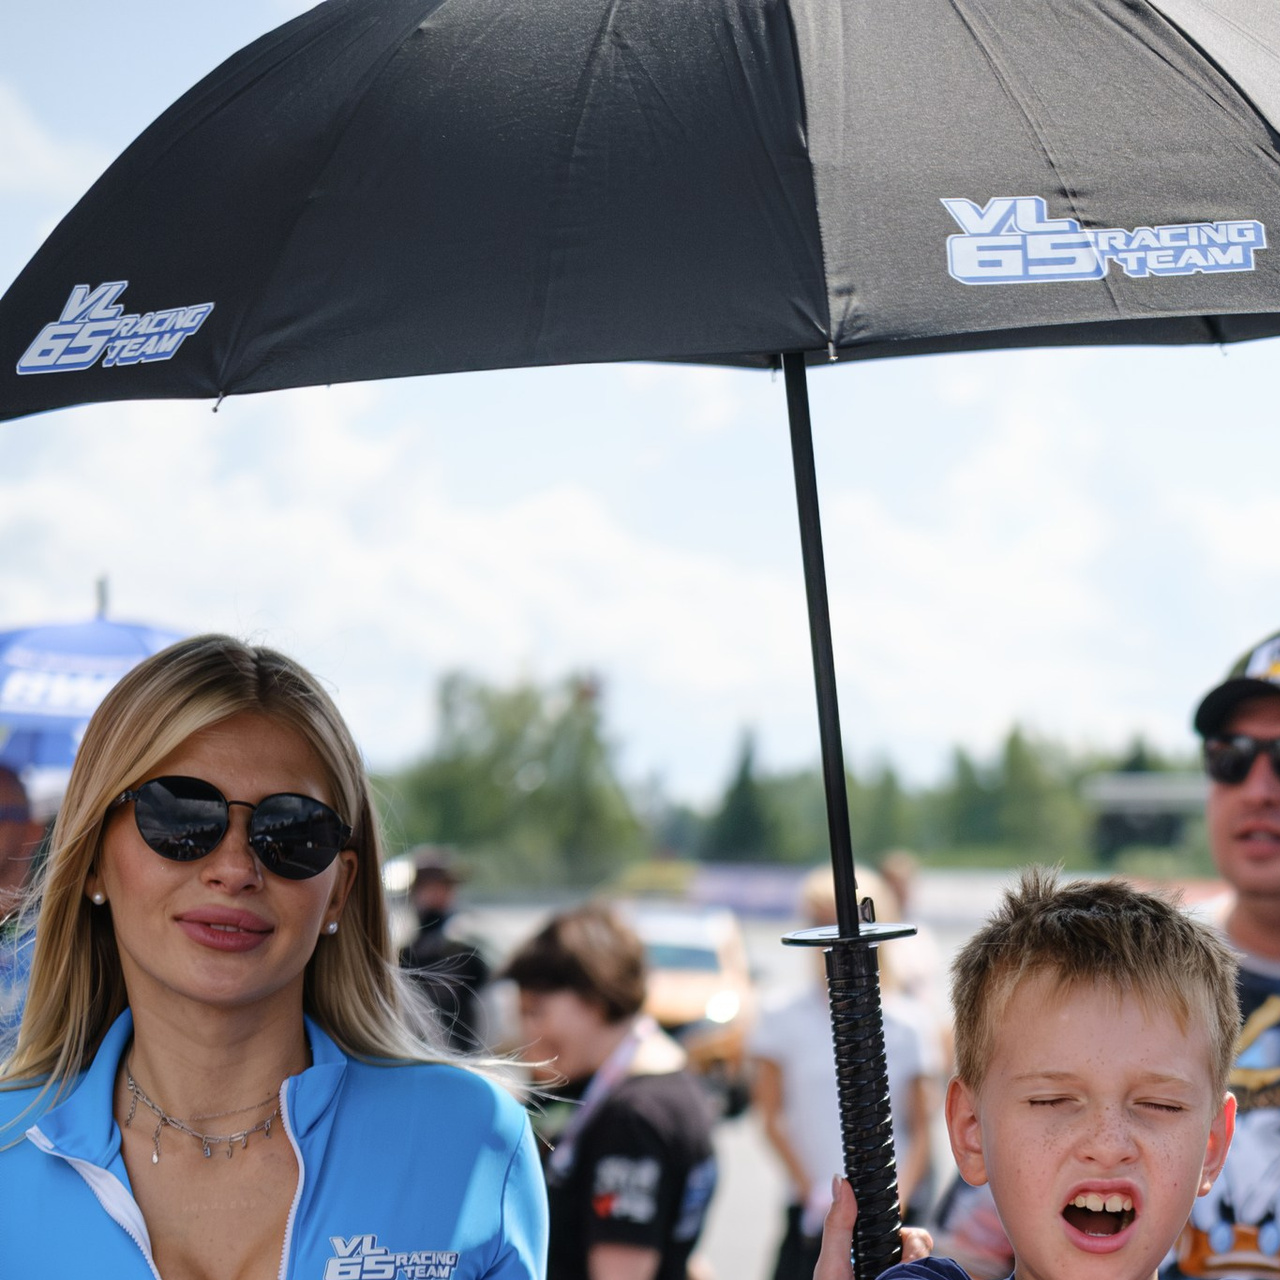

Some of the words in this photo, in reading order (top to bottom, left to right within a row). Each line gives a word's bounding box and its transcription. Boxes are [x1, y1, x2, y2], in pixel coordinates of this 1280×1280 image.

[944, 198, 1071, 234] VL
[1099, 222, 1257, 250] RACING
[949, 233, 1098, 278] 65
[1117, 247, 1243, 271] TEAM
[60, 283, 126, 322] VL
[110, 304, 206, 338] RACING
[18, 319, 121, 369] 65
[108, 331, 185, 360] TEAM
[330, 1235, 386, 1257] VL
[395, 1252, 457, 1266] RACING
[323, 1255, 397, 1280] 65
[403, 1265, 450, 1279] TEAM
